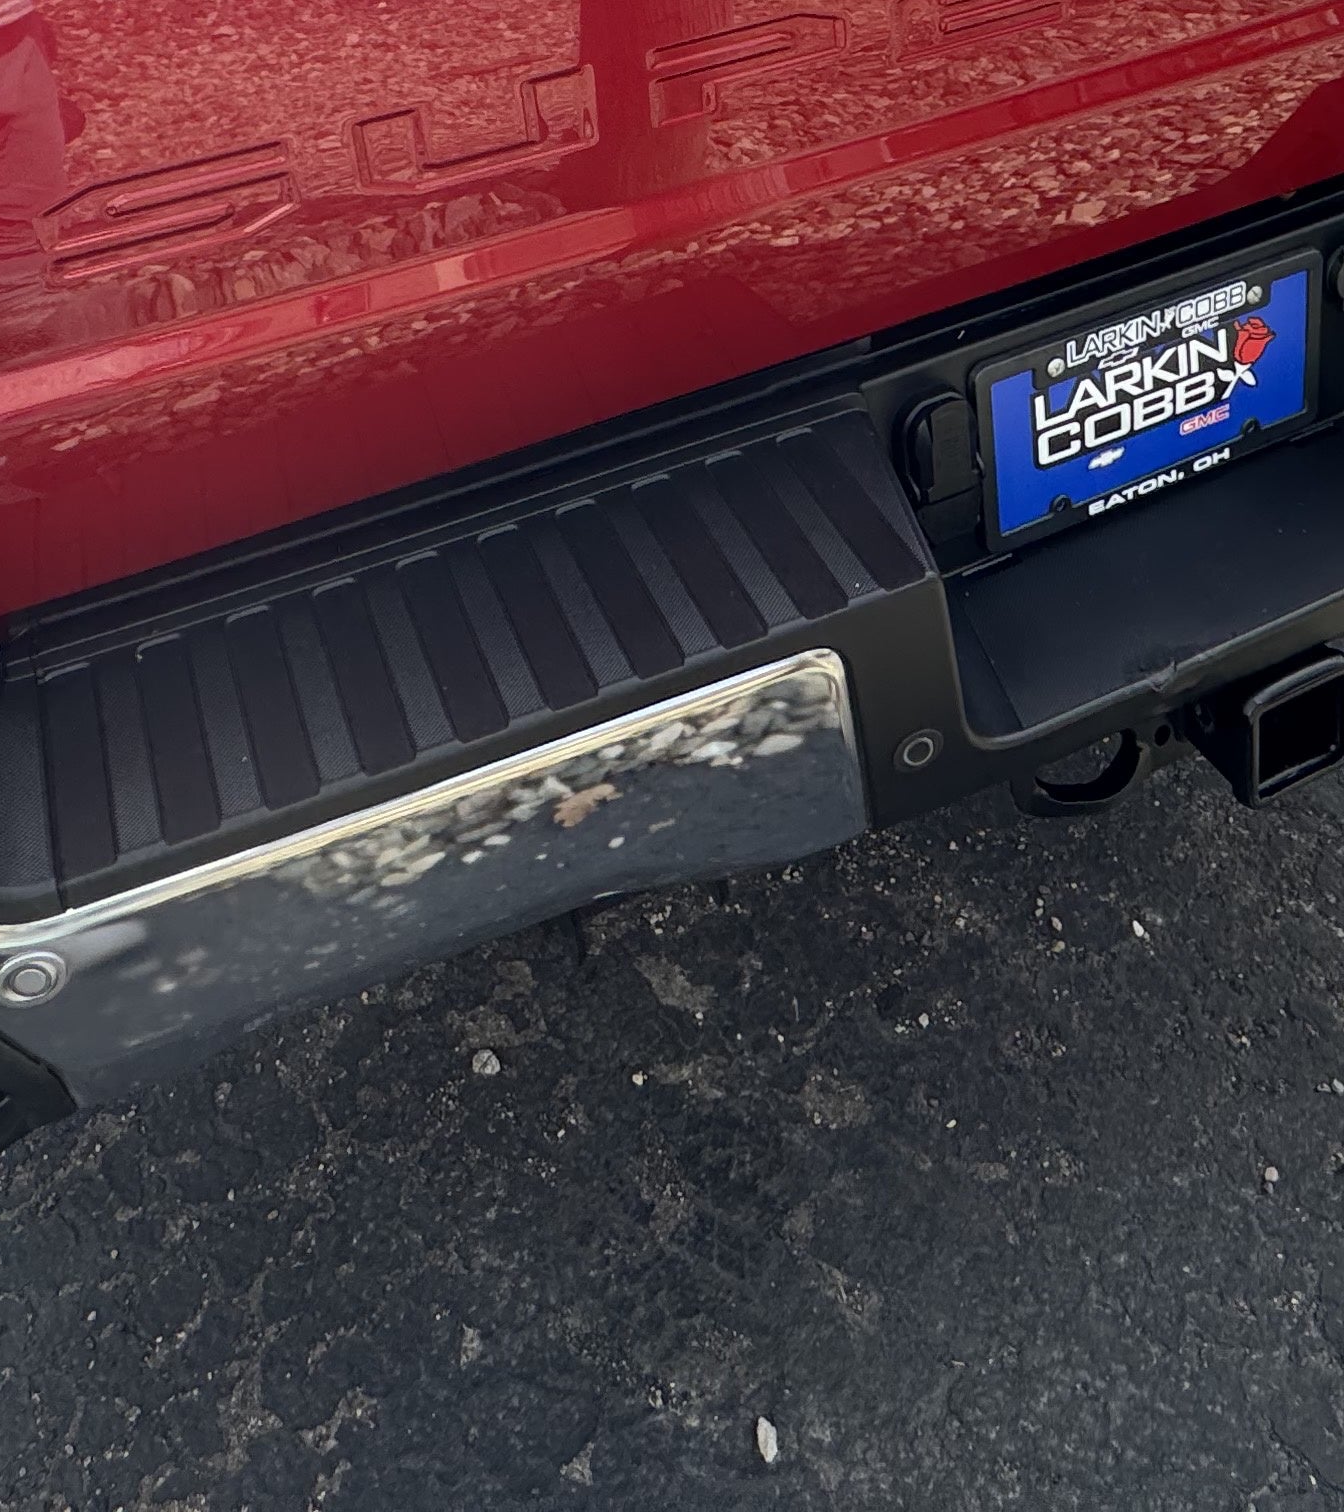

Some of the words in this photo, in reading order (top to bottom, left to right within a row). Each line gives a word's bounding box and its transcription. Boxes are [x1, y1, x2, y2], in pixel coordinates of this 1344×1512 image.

[1066, 310, 1161, 368] LARKIN
[1175, 281, 1247, 328] COBB
[1182, 316, 1220, 339] GMC
[1034, 328, 1228, 431] LARKIN
[1037, 371, 1219, 466] COBB
[1179, 404, 1230, 436] GMC
[1088, 469, 1185, 516] EATON,
[1193, 446, 1230, 472] OH
